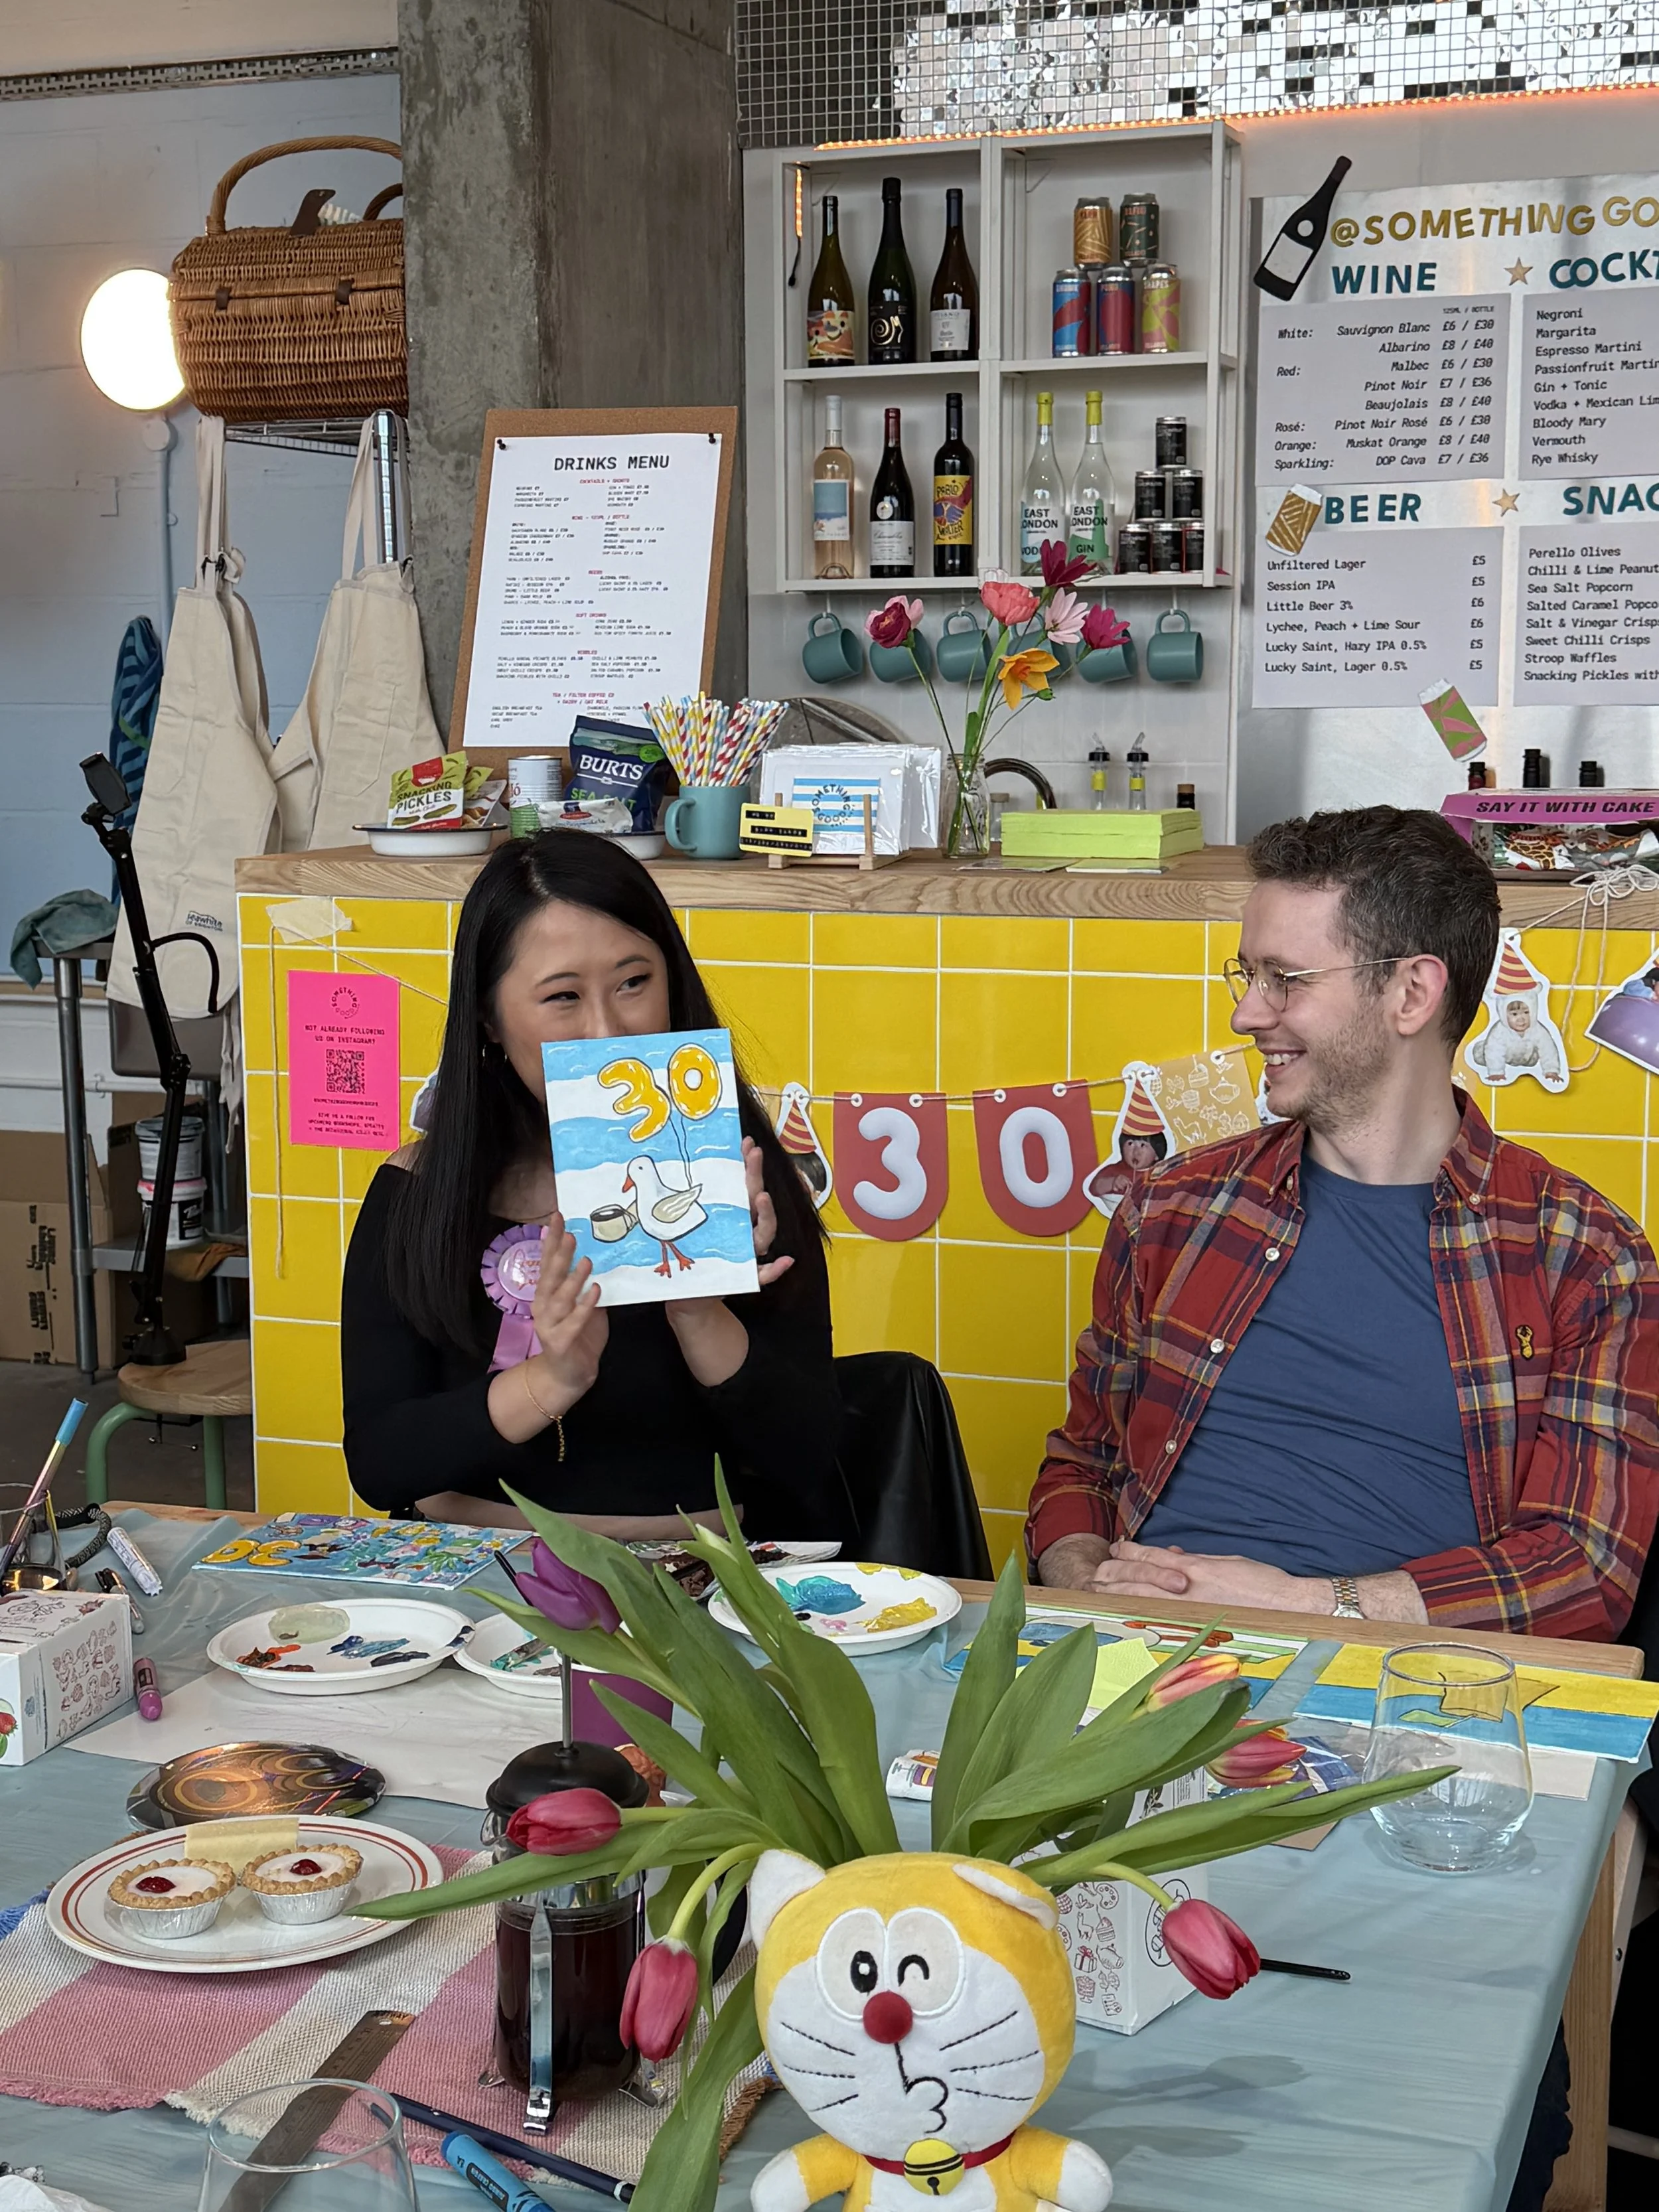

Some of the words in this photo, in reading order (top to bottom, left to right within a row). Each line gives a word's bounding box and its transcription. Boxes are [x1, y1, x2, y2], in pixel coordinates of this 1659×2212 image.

[1330, 203, 1595, 248] @SOMETHING
[1602, 196, 1659, 228] GO
[1332, 262, 1437, 295] WINE
[1537, 308, 1583, 322] Negroni
[1278, 329, 1313, 338] White:
[1337, 325, 1393, 337] Sauvignon
[1399, 323, 1430, 333] Blanc
[1443, 321, 1455, 331] £6
[1475, 319, 1494, 330] £30
[1536, 327, 1596, 340] Margarita
[1442, 340, 1455, 350] £8
[1474, 338, 1493, 348] £40
[1536, 346, 1589, 358] Espresso
[1595, 341, 1642, 353] Martini
[1277, 366, 1300, 376] Red:
[1391, 360, 1429, 371] Malbec
[1441, 359, 1454, 369] £6
[1473, 358, 1492, 368] £30
[1535, 361, 1614, 374] Passionfruit
[1364, 382, 1396, 391] Pinot
[1402, 380, 1427, 390] Noir
[1440, 378, 1453, 388] £7
[1473, 377, 1492, 387] £36
[1534, 382, 1555, 392] Gin
[1574, 380, 1607, 390] Tonic
[1366, 398, 1428, 411] Beaujolais
[1440, 398, 1453, 407] £8
[1471, 396, 1491, 406] £40
[1534, 400, 1567, 410] Vodka
[1587, 398, 1633, 407] Mexican
[1275, 422, 1305, 432] Rosé:
[1335, 420, 1365, 429] Pinot
[1371, 419, 1396, 428] Noir
[1402, 417, 1427, 427] Rosé
[1439, 416, 1453, 426] £6
[1471, 415, 1490, 425] £30
[1533, 417, 1573, 429] Bloody
[1579, 417, 1606, 427] Mary
[1275, 441, 1316, 452] Orange:
[1346, 438, 1383, 448] Muskat
[1389, 437, 1427, 448] Orange
[1439, 435, 1452, 445] £8
[1471, 434, 1490, 444] £40
[1532, 435, 1585, 446] Vermouth
[555, 457, 616, 471] DRINKS
[628, 455, 669, 469] MENU
[1275, 458, 1334, 471] Sparkling:
[1376, 456, 1396, 466] DOP
[1401, 455, 1425, 465] Cava
[1438, 454, 1452, 464] £7
[1469, 453, 1488, 463] £36
[1532, 455, 1551, 467] Rye
[1558, 452, 1598, 465] Whisky
[1025, 508, 1050, 518] EAST
[1074, 506, 1099, 515] EAST
[1325, 493, 1421, 525] BEER
[1076, 544, 1094, 553] GIN
[1581, 546, 1621, 557] Olives
[1268, 559, 1329, 570] Unfiltered
[1335, 559, 1366, 571] Lager
[1473, 555, 1485, 565] £5
[1528, 565, 1567, 575] Chilli
[1587, 565, 1614, 574] Lime
[1267, 581, 1310, 591] Session
[1317, 580, 1335, 589] IPA
[1472, 577, 1485, 586] £5
[1528, 584, 1548, 593] Sea
[1553, 582, 1579, 593] Salt
[1587, 583, 1632, 594] Popcorn
[1267, 601, 1303, 611] Little
[1309, 601, 1334, 611] Beer
[1340, 601, 1353, 610] 3%
[1471, 598, 1484, 607] £6
[1527, 601, 1566, 611] Salted
[1572, 599, 1618, 610] Caramel
[1625, 599, 1658, 611] Popco
[1267, 622, 1307, 634] Lychee,
[1315, 621, 1346, 630] Peach
[1364, 621, 1390, 630] Lime
[1396, 620, 1420, 629] Sour
[1471, 619, 1483, 628] £6
[1526, 618, 1552, 628] Salt
[1571, 618, 1618, 630] Vinegar
[1266, 642, 1297, 654] Lucky
[1302, 642, 1337, 652] Saint,
[1345, 642, 1370, 653] Hazy
[1377, 641, 1396, 650] IPA
[1401, 640, 1427, 650] 0.5%
[1471, 639, 1482, 649] £5
[1526, 636, 1558, 646] Sweet
[1564, 634, 1603, 645] Chilli
[1610, 635, 1650, 646] Crisps
[1525, 654, 1564, 665] Stroop
[1570, 652, 1617, 662] Waffles
[1265, 662, 1296, 674] Lucky
[1302, 662, 1336, 673] Saint,
[1345, 662, 1376, 674] Lager
[1382, 661, 1407, 671] 0.5%
[1470, 660, 1482, 670] £5
[1524, 670, 1577, 682] Snacking
[1583, 670, 1628, 680] Pickles
[580, 755, 644, 780] BURTS
[397, 781, 452, 802] SNACKING
[571, 788, 595, 800] SEA
[396, 791, 452, 814] PICKLES
[812, 784, 851, 814] SOMETHING
[1477, 802, 1515, 812] SAY
[1520, 802, 1540, 812] IT
[1546, 802, 1597, 812] WITH
[1602, 802, 1656, 812] CAKE
[818, 809, 846, 823] GOOD
[597, 1042, 723, 1143] 30
